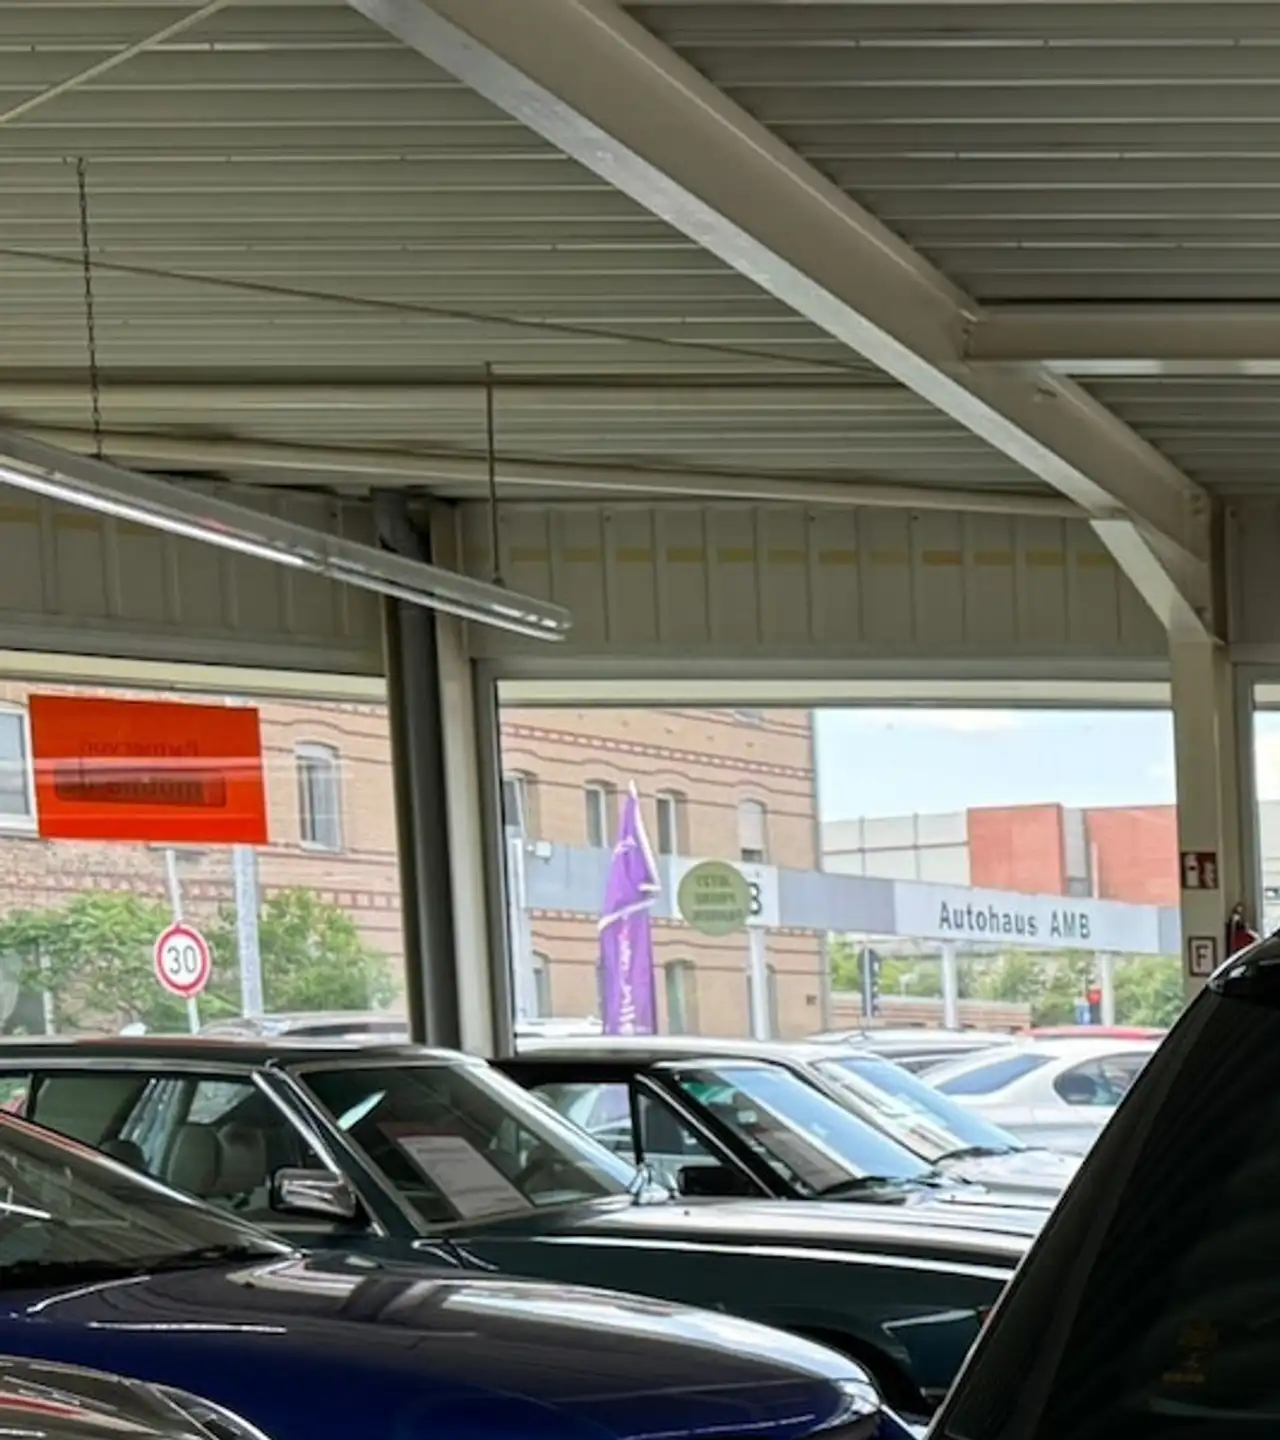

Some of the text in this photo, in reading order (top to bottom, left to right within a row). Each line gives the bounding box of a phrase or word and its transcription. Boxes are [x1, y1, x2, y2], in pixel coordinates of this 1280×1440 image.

[938, 901, 1091, 940] Autohaus AMB
[167, 945, 197, 974] 30
